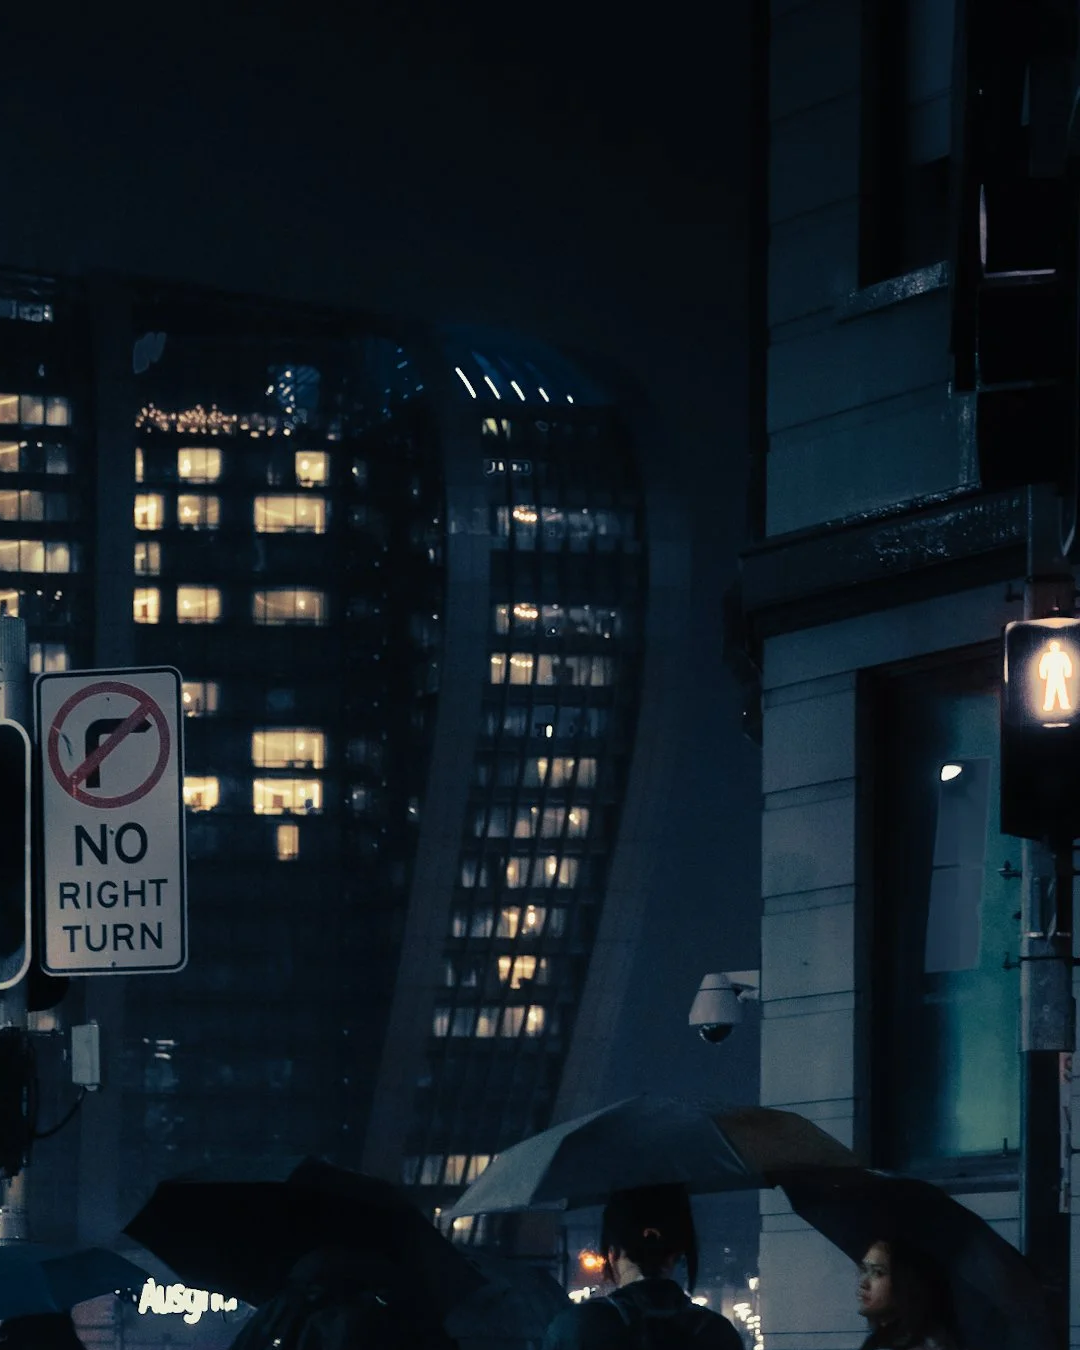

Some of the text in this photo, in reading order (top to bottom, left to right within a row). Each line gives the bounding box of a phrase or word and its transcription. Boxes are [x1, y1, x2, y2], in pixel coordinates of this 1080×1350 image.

[75, 822, 148, 866] NO
[59, 878, 168, 909] RIGHT
[62, 921, 163, 953] TURN
